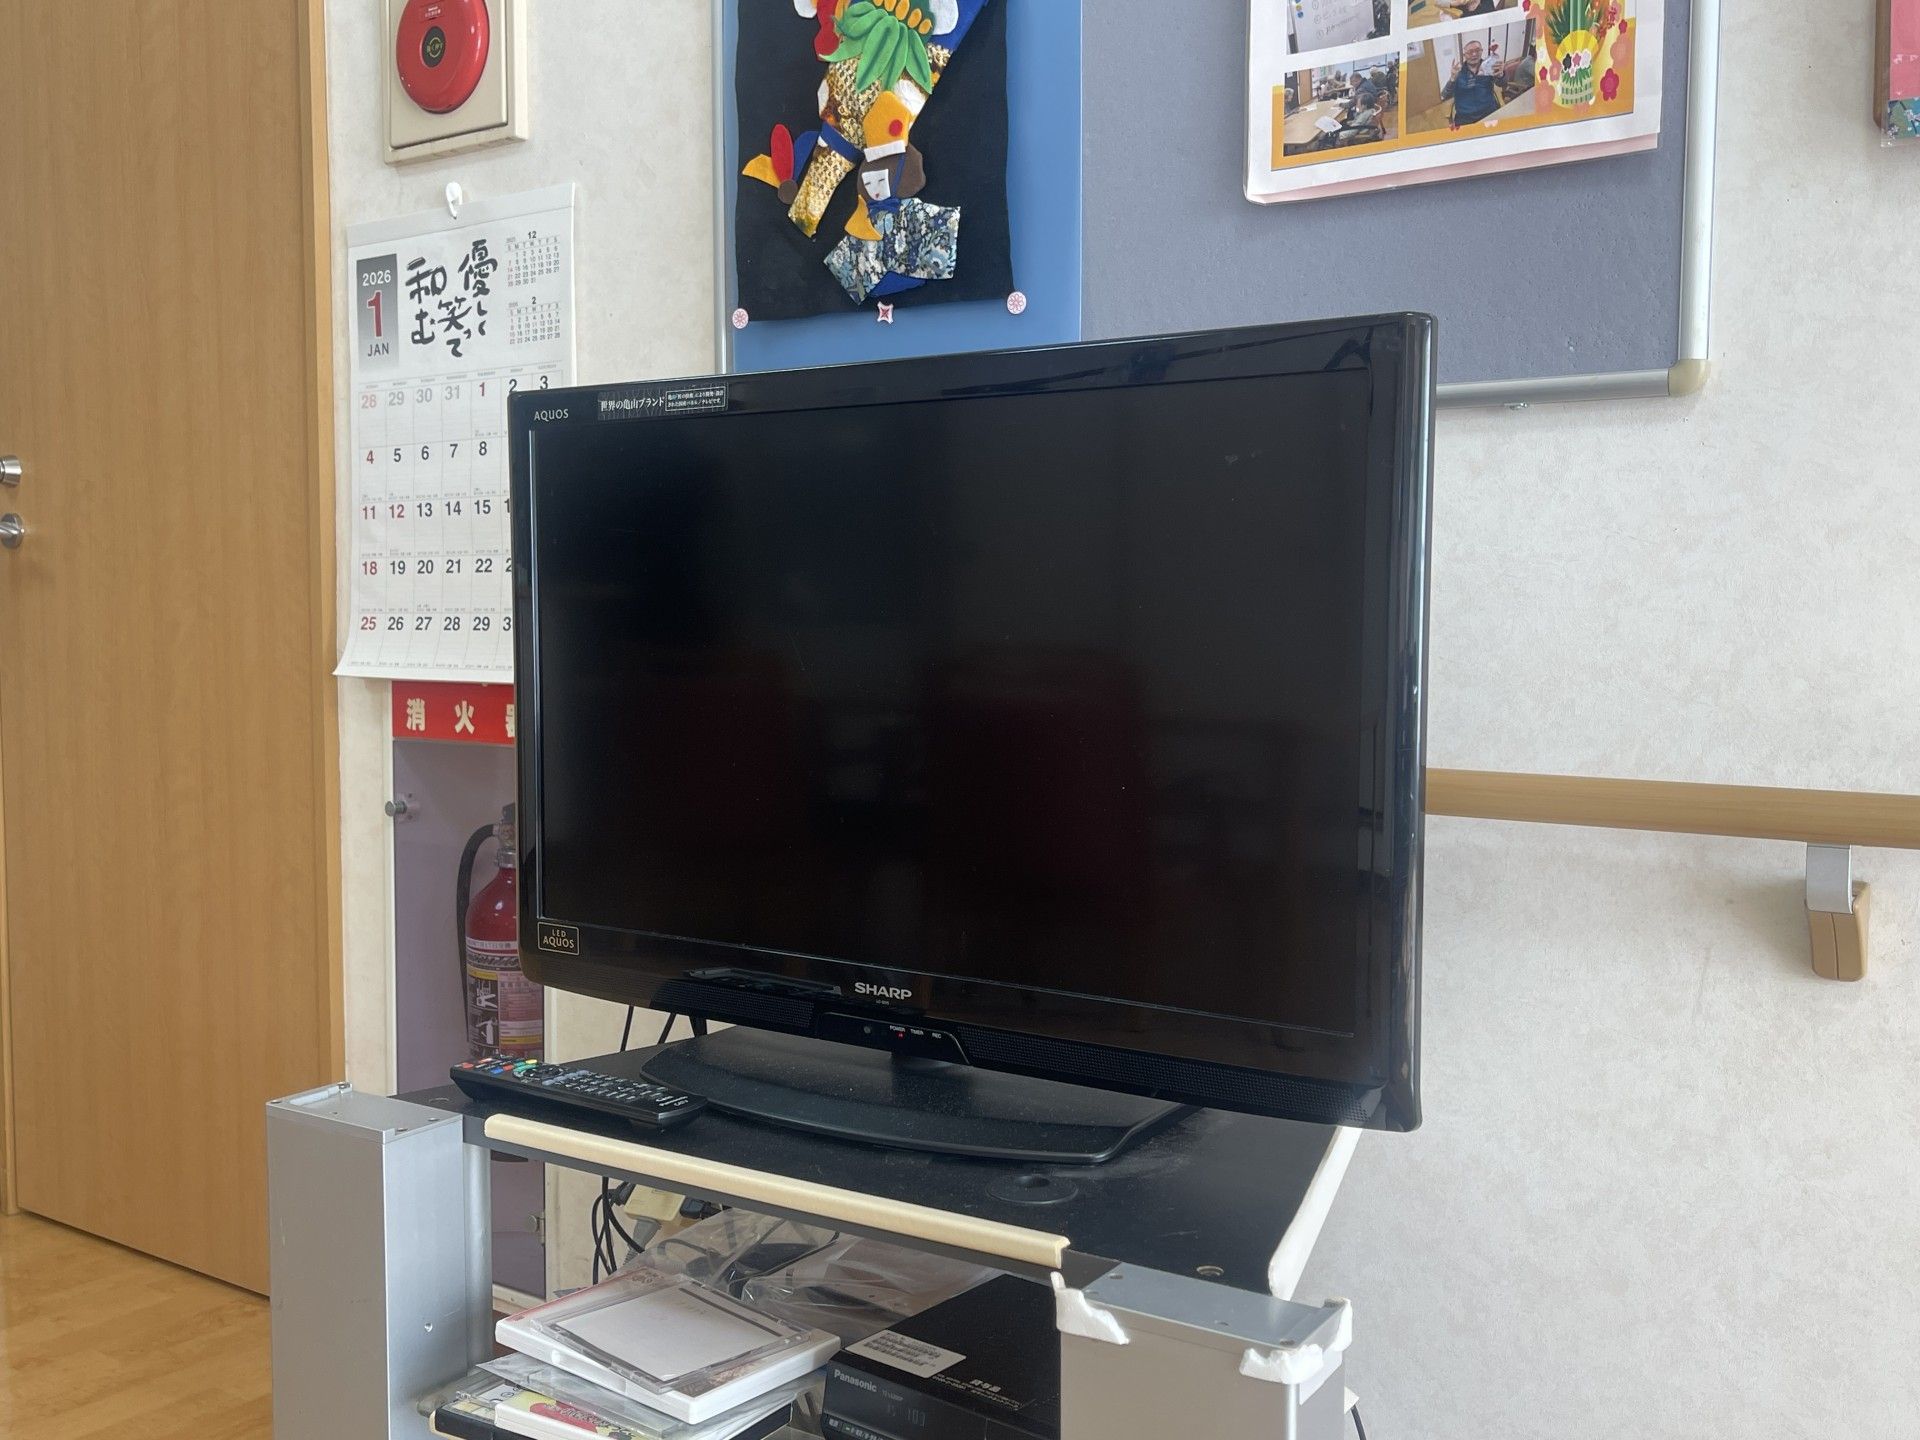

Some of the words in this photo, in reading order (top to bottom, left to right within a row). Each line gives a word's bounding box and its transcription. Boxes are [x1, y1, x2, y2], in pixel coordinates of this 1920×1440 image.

[528, 231, 537, 239] 12
[362, 270, 391, 287] 2026
[458, 239, 498, 336] 優しく
[405, 256, 447, 344] 和む
[531, 296, 537, 304] 2
[367, 290, 382, 337] 1
[437, 296, 472, 357] 笑って
[367, 342, 390, 357] JAN
[361, 392, 378, 410] 28
[388, 390, 406, 407] 29
[416, 387, 434, 404] 30
[444, 384, 461, 401] 31
[478, 381, 486, 398] 1
[509, 379, 518, 392] 2
[540, 375, 548, 390] 3
[600, 396, 664, 412] 世界の亀山ブランド
[534, 408, 569, 421] AQUOS
[365, 449, 375, 465] 4
[393, 447, 402, 463] 5
[420, 444, 430, 461] 6
[449, 442, 459, 459] 7
[478, 440, 488, 457] 8
[362, 505, 377, 521] 11
[388, 503, 406, 520] 12
[416, 501, 433, 518] 13
[444, 500, 462, 517] 14
[473, 498, 492, 516] 15
[504, 498, 510, 513] 1
[361, 560, 378, 576] 18
[389, 559, 407, 576] 19
[416, 558, 435, 575] 20
[444, 558, 463, 575] 21
[474, 557, 493, 574] 22
[505, 557, 512, 573] 2
[359, 615, 377, 632] 25
[386, 615, 405, 632] 26
[414, 615, 433, 632] 27
[442, 615, 461, 632] 28
[472, 615, 491, 632] 29
[502, 616, 511, 631] 3
[552, 929, 566, 937] LED
[543, 935, 575, 949] AQUOS
[854, 982, 913, 1000] SHARP
[889, 1025, 906, 1033] POWER
[834, 1369, 877, 1393] Panasonic
